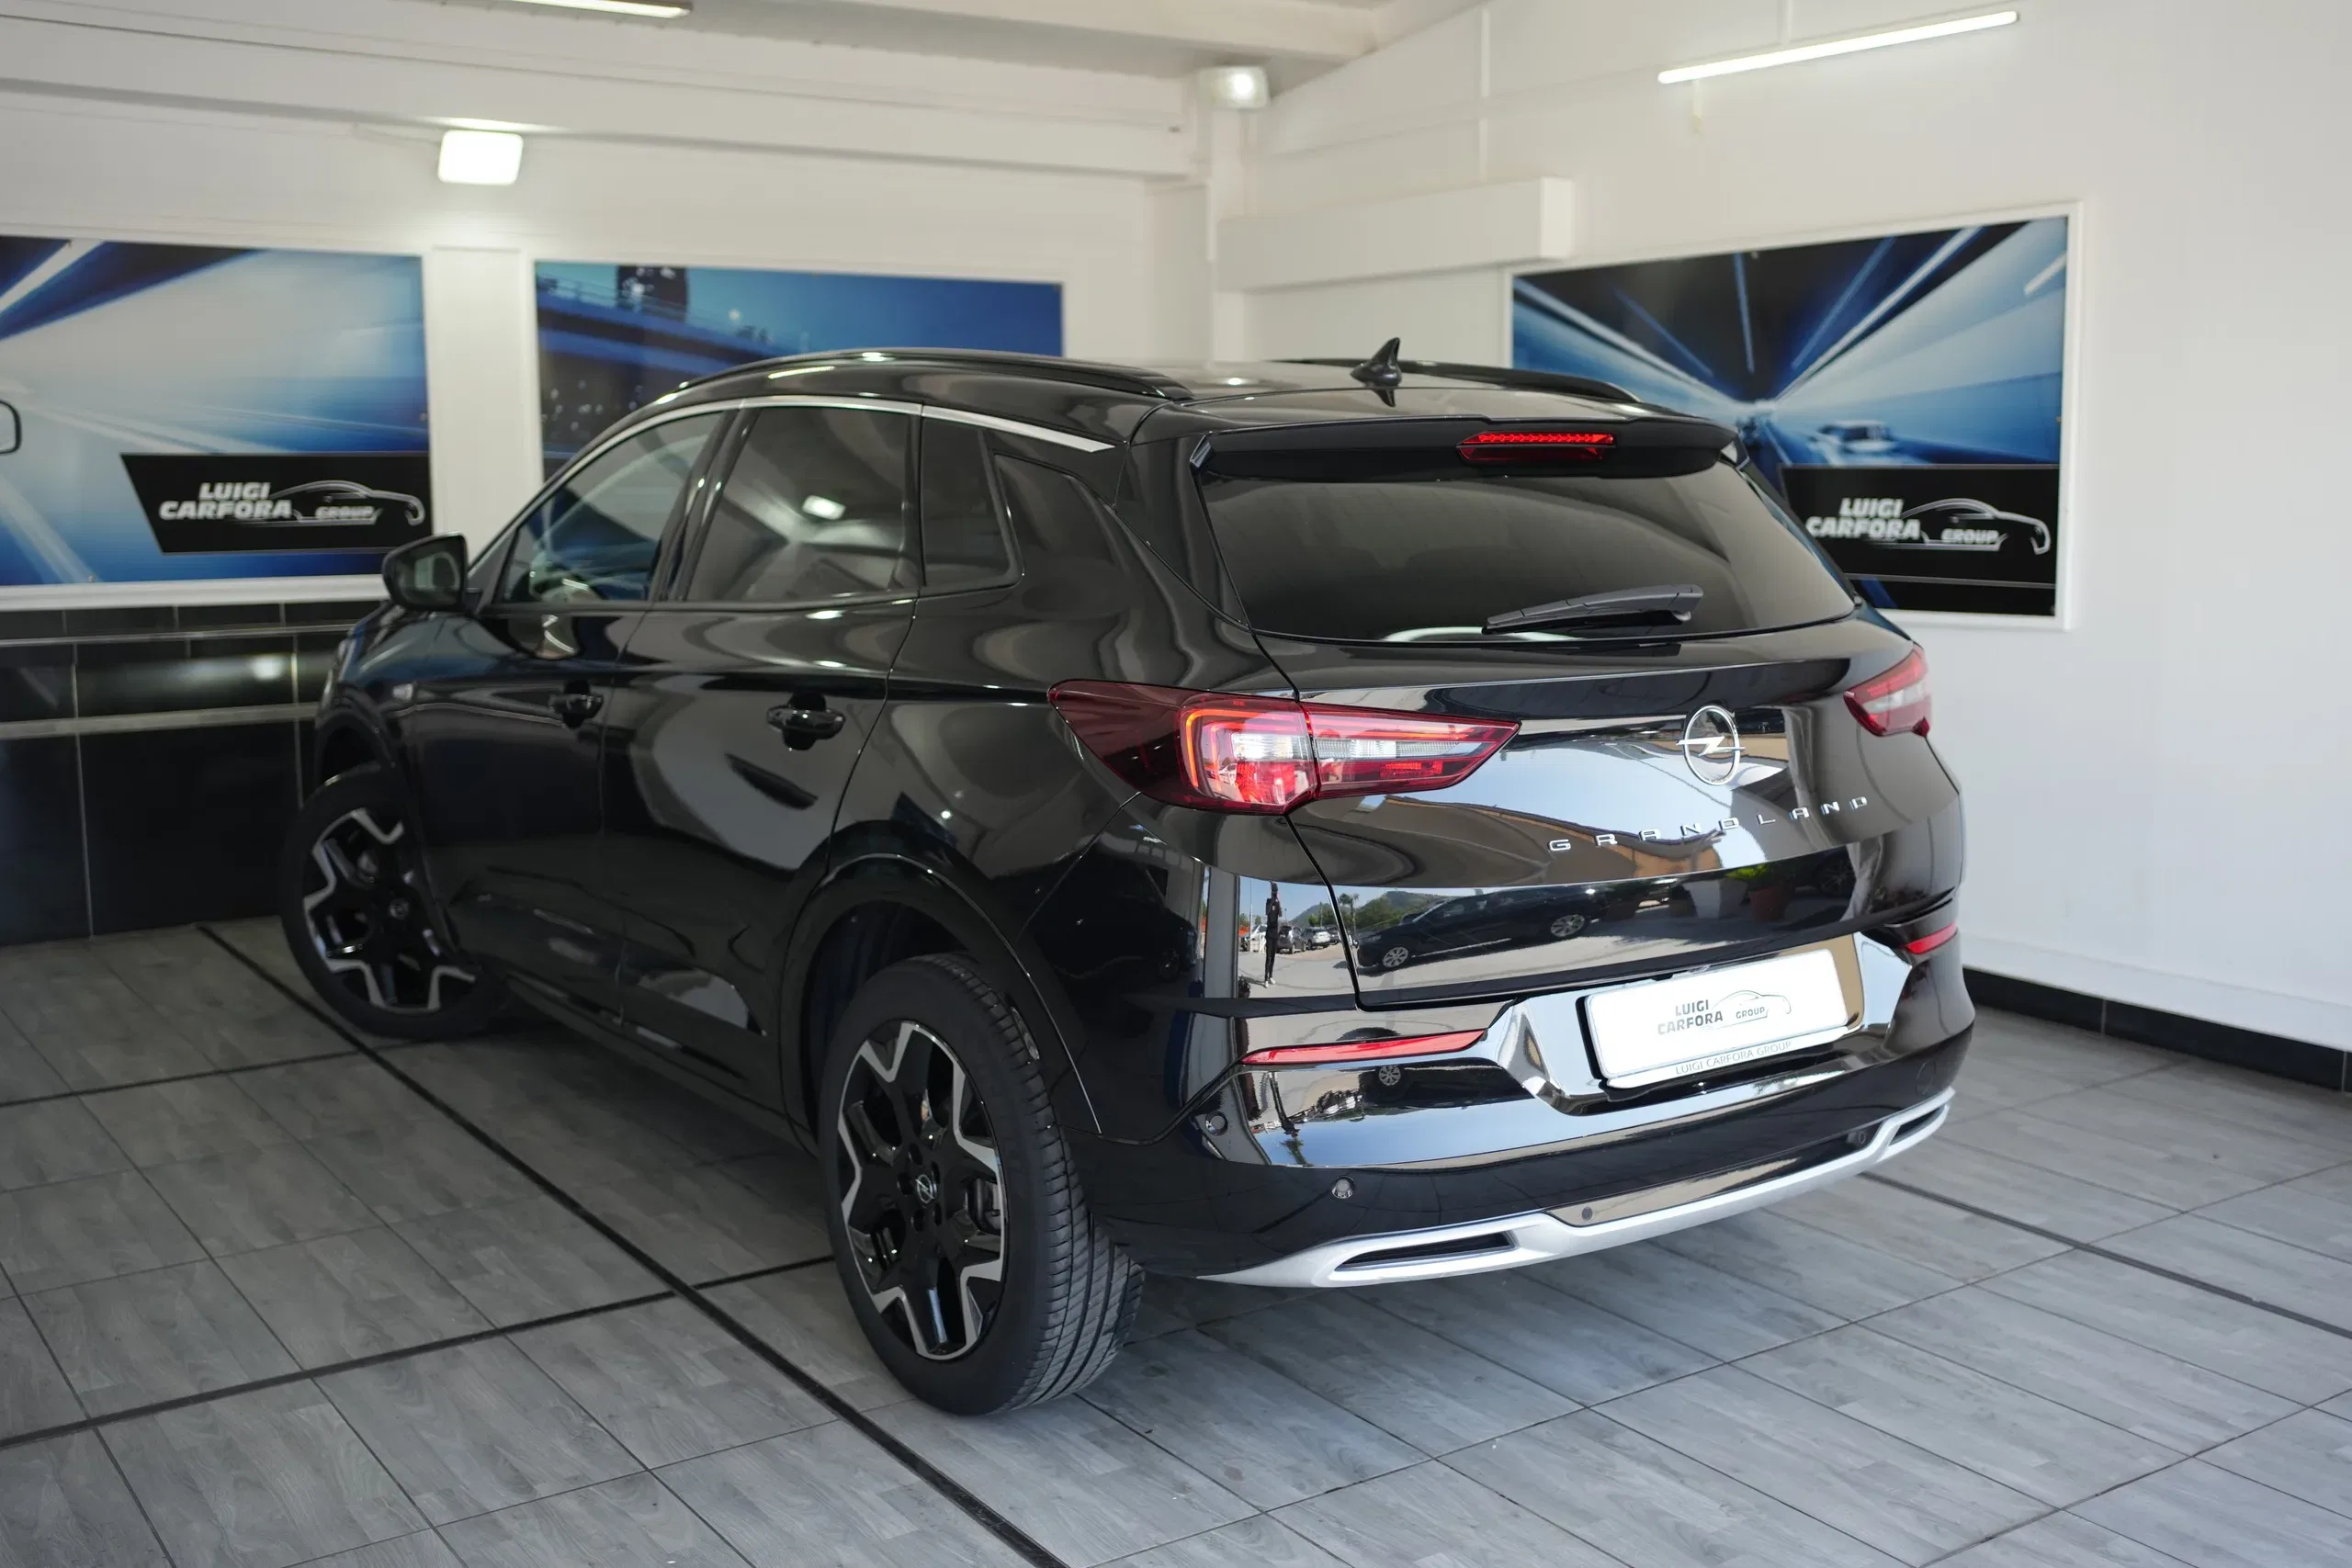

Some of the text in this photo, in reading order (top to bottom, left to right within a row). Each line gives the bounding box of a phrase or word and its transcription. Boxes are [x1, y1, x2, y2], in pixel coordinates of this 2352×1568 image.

[198, 482, 270, 501] LUIGI
[159, 501, 375, 520] CARFORA GROUP
[1839, 497, 1904, 518] LUIGI
[1805, 515, 1999, 544] CARFORA GROUP
[1548, 796, 1868, 852] GRANDLAND
[1675, 999, 1709, 1017] LUIGI
[1657, 1007, 1765, 1035] CARFORA GROUP
[1675, 1041, 1792, 1075] LUIGI CARFORA GROUP
